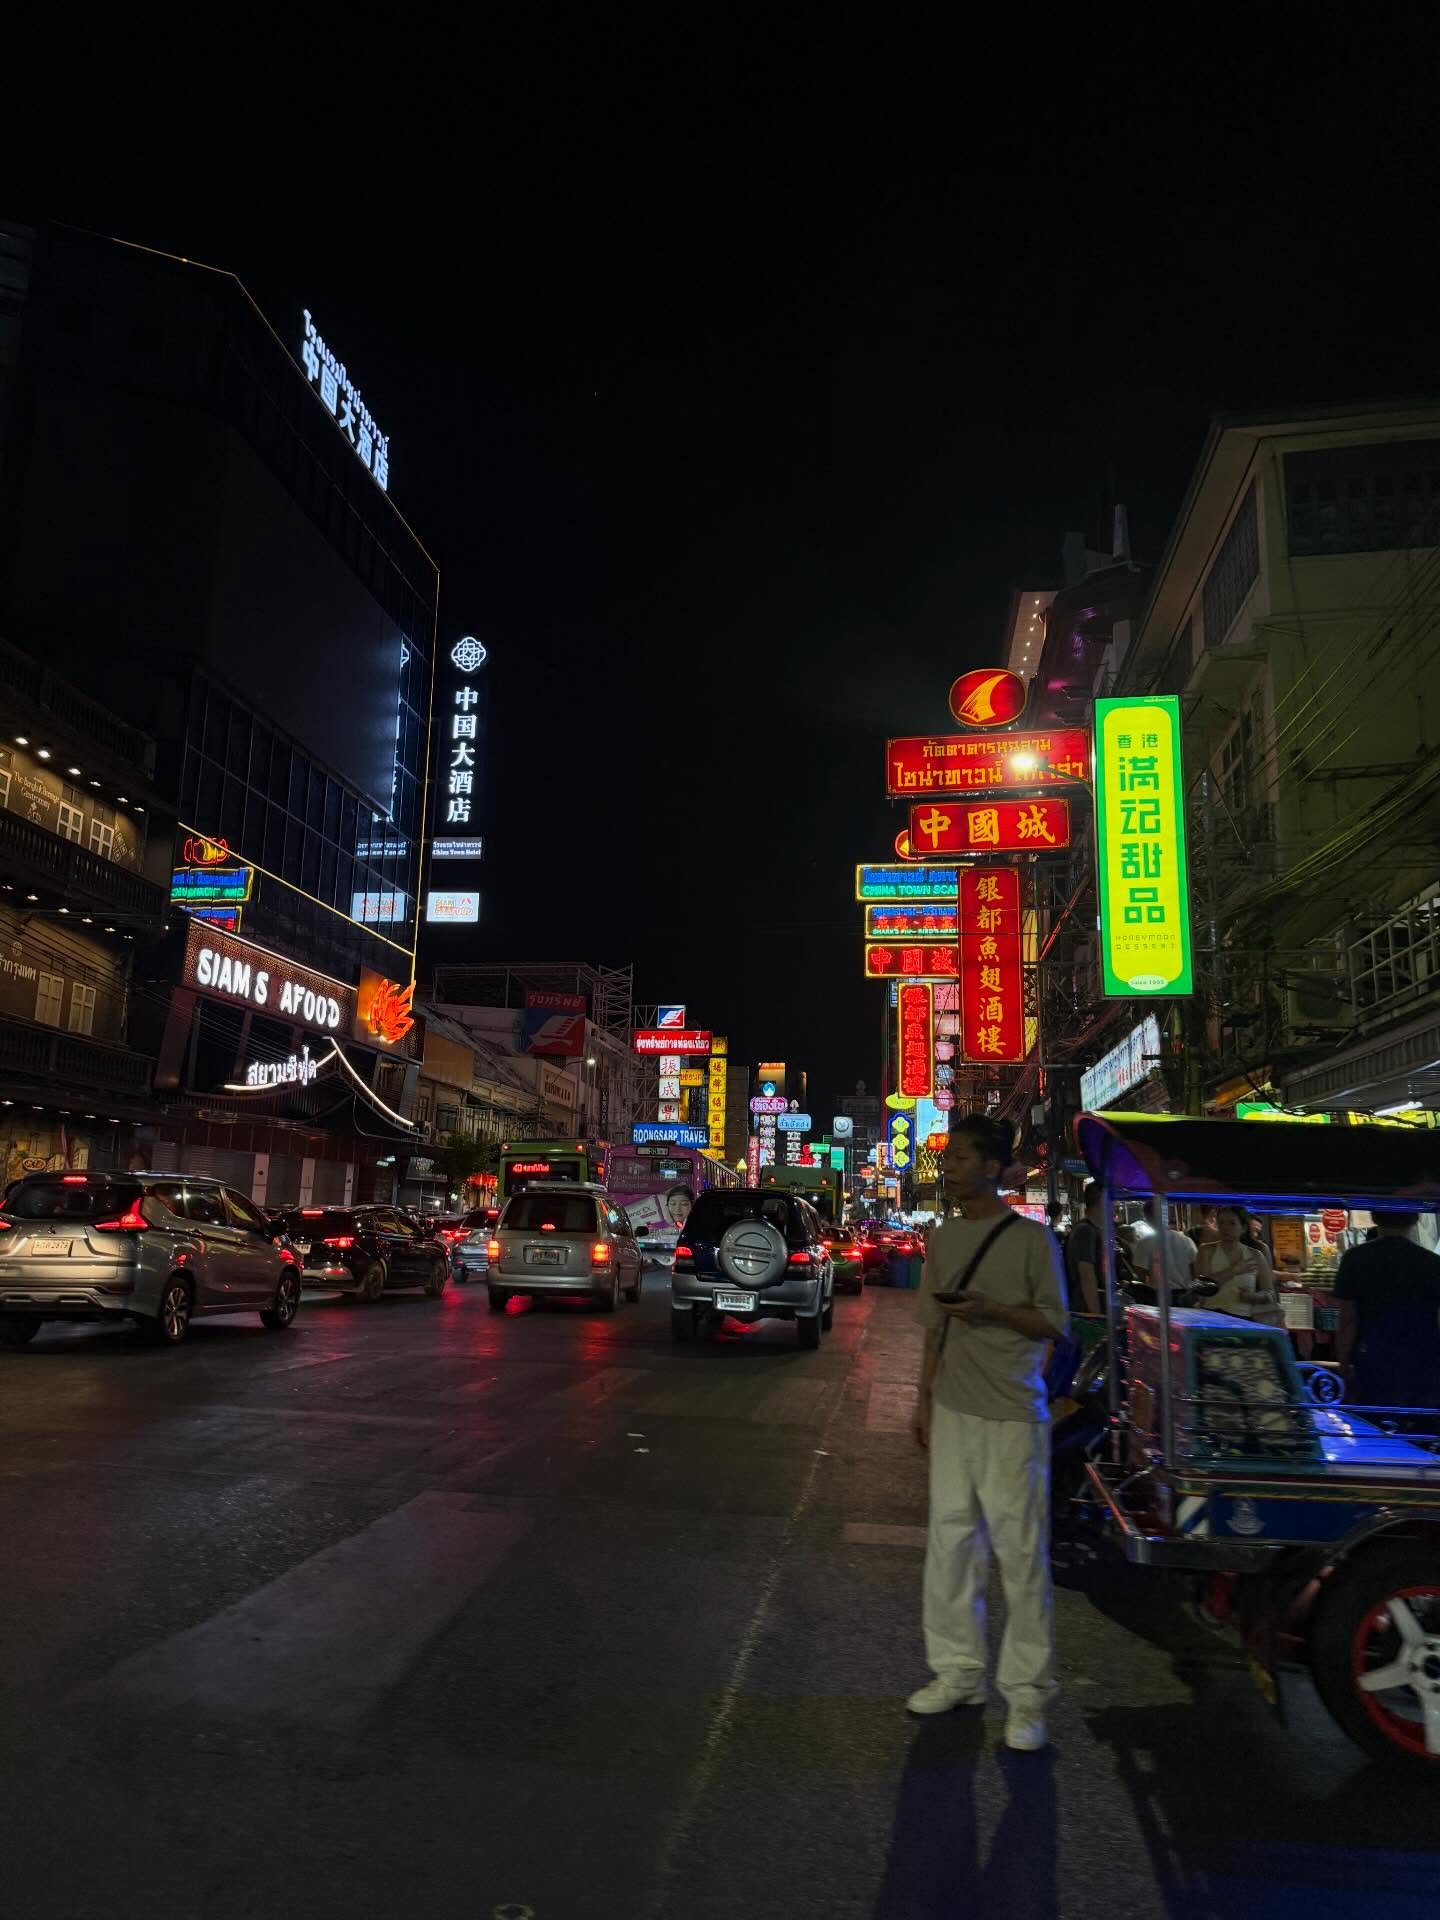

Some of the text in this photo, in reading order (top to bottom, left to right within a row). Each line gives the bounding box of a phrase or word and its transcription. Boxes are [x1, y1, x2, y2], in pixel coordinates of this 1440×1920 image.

[447, 686, 479, 823] 中国大酒店
[1117, 734, 1158, 748] 香港
[893, 760, 1003, 787] ไชน่าทาวน์
[919, 805, 1056, 848] 中國城
[863, 885, 897, 896] CHINA
[899, 885, 931, 895] TOWN
[197, 948, 251, 998] SIAM
[870, 946, 957, 975] 中國城
[976, 876, 1006, 1055] 銀都魚翅酒樓
[633, 1129, 708, 1143] ROONGSARP TRAVEL
